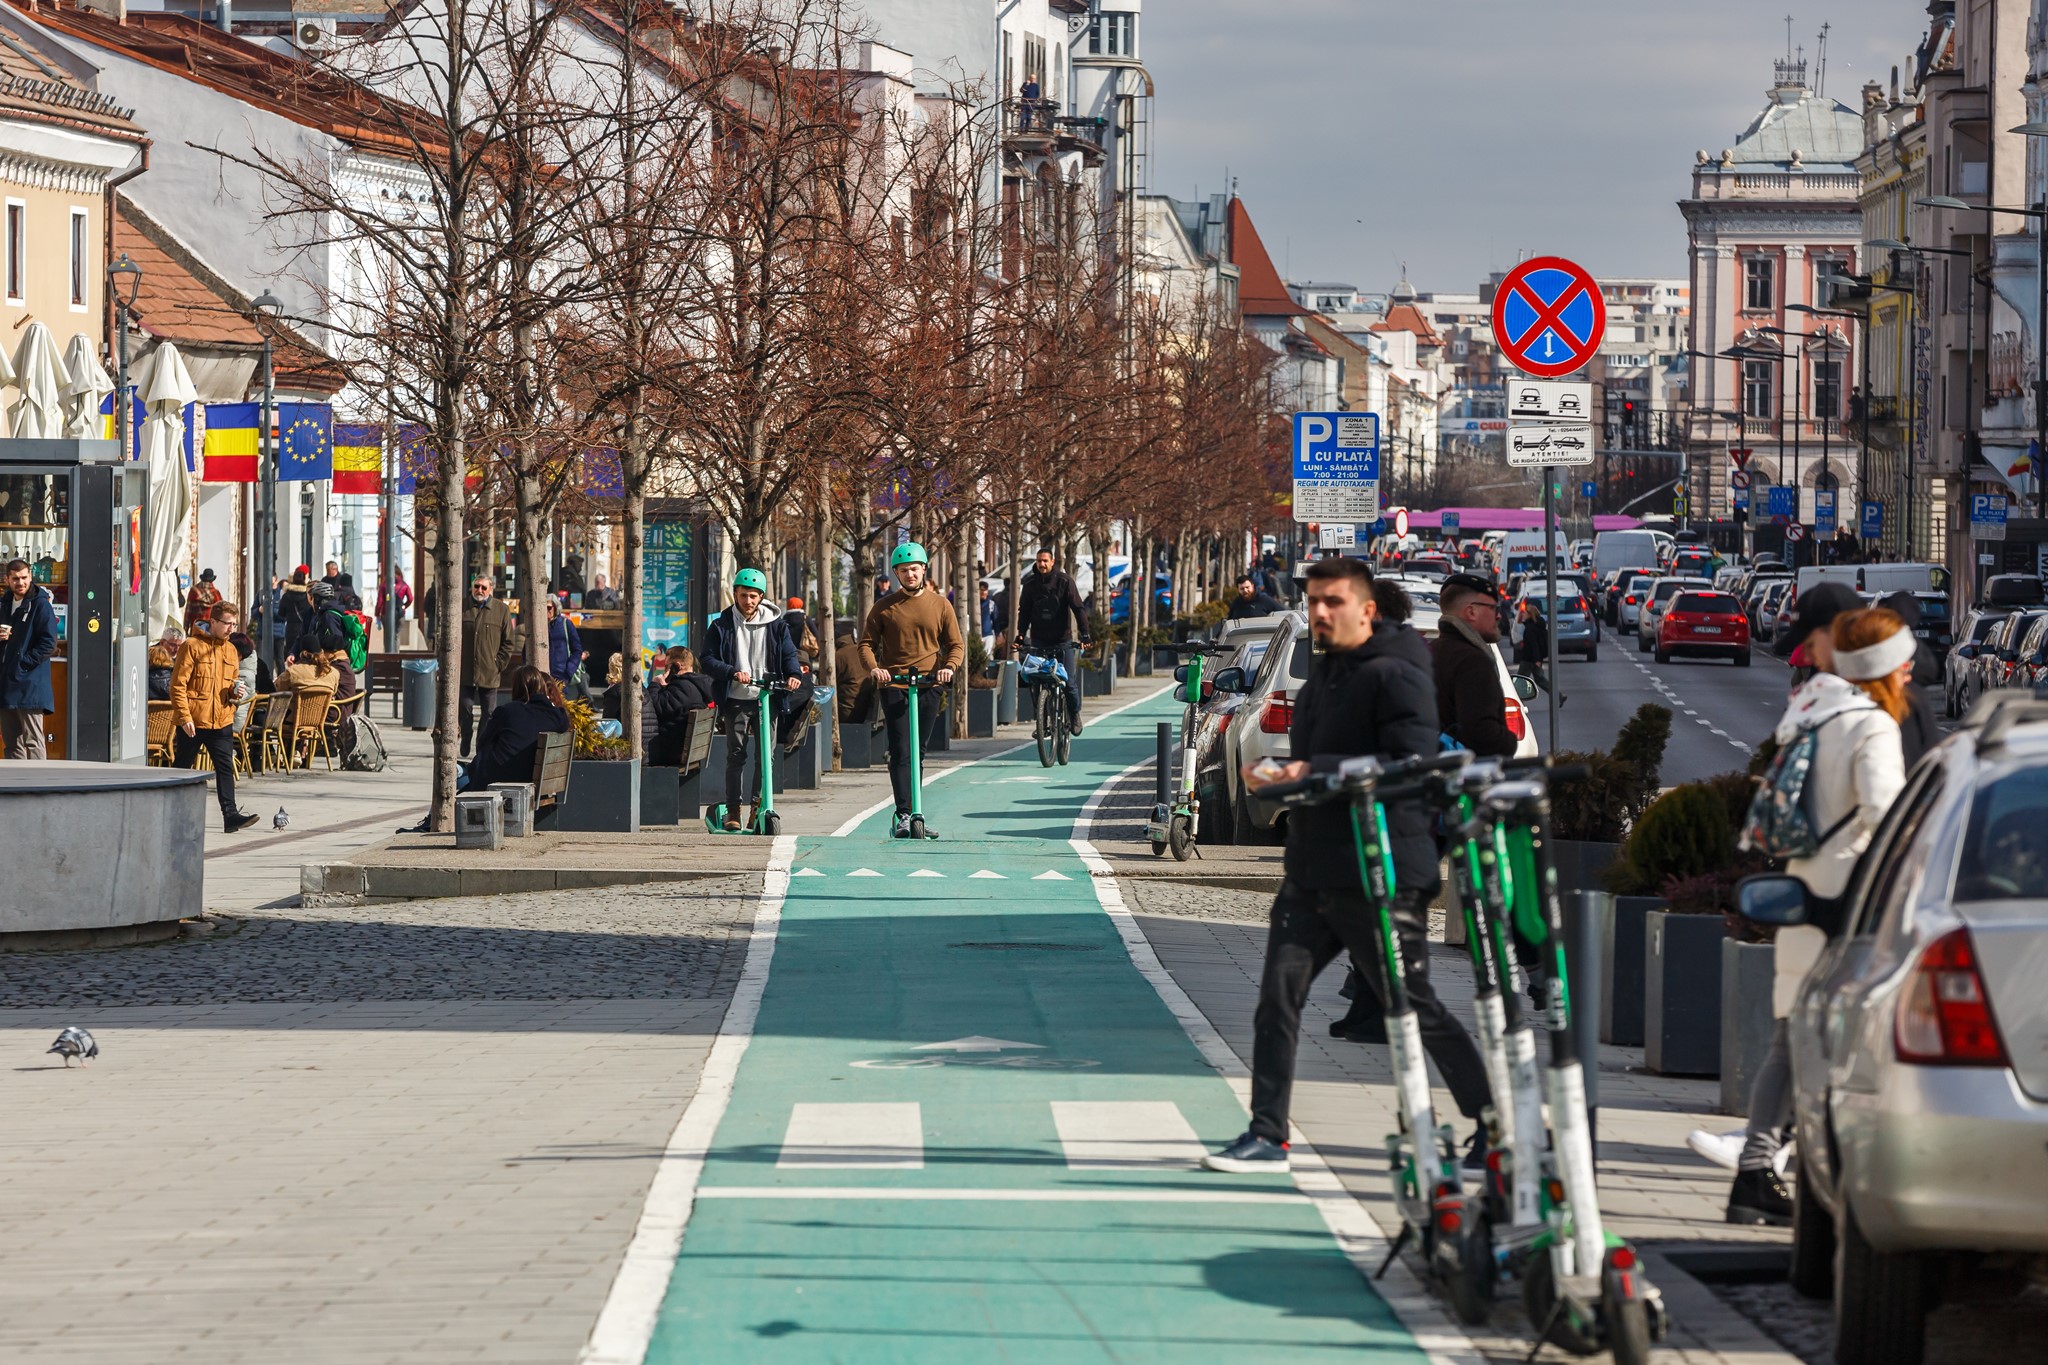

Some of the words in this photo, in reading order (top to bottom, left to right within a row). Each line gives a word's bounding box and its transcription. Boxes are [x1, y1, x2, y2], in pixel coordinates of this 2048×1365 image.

[1301, 416, 1332, 462] P
[1315, 451, 1332, 462] CU
[1335, 450, 1373, 462] PLATĂ
[1865, 505, 1878, 521] P
[1974, 496, 1988, 515] P
